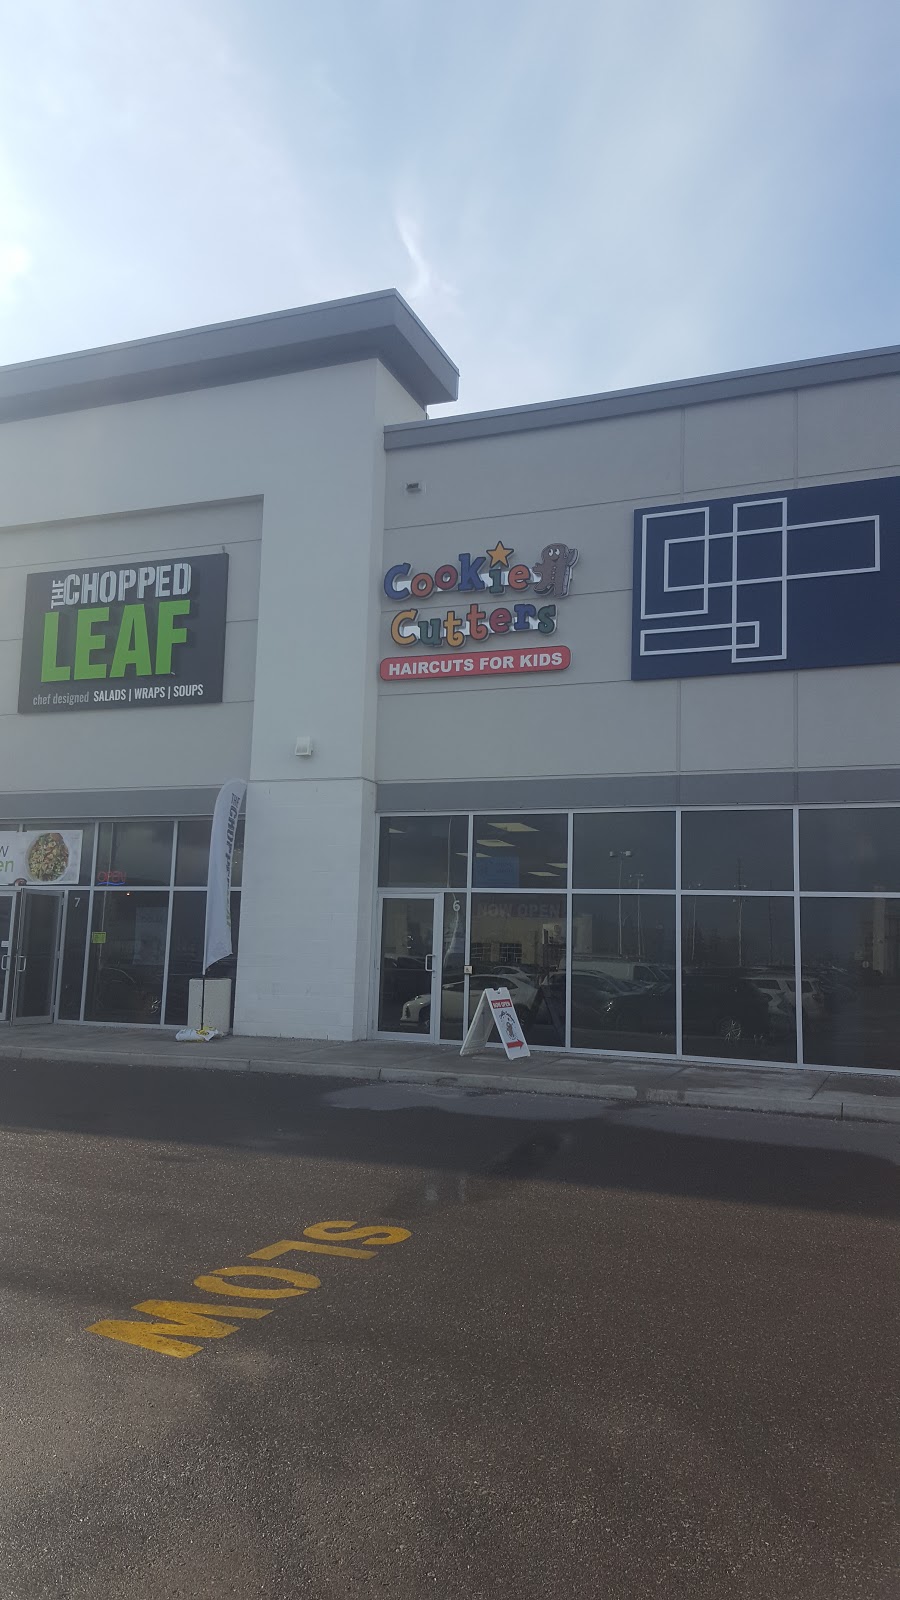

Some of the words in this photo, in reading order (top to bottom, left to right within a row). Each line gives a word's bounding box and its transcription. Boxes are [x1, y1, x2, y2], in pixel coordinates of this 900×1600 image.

[63, 563, 192, 606] CHOPPED
[384, 541, 531, 600] Cookie
[51, 580, 65, 609] THE
[391, 604, 557, 648] Cutters
[41, 600, 190, 682] LEAF
[388, 658, 474, 676] HAIRCUTS
[479, 656, 514, 671] FOR
[520, 652, 563, 668] KIDS
[33, 693, 51, 706] chef
[52, 691, 89, 706] designed
[93, 688, 127, 702] SALADS
[134, 686, 166, 700] WRAPS
[173, 684, 204, 697] SOUPS
[74, 897, 81, 908] 7
[453, 900, 461, 912] 6
[477, 903, 513, 918] NOW
[518, 902, 561, 918] OPEN
[84, 1220, 412, 1359] SLOW
